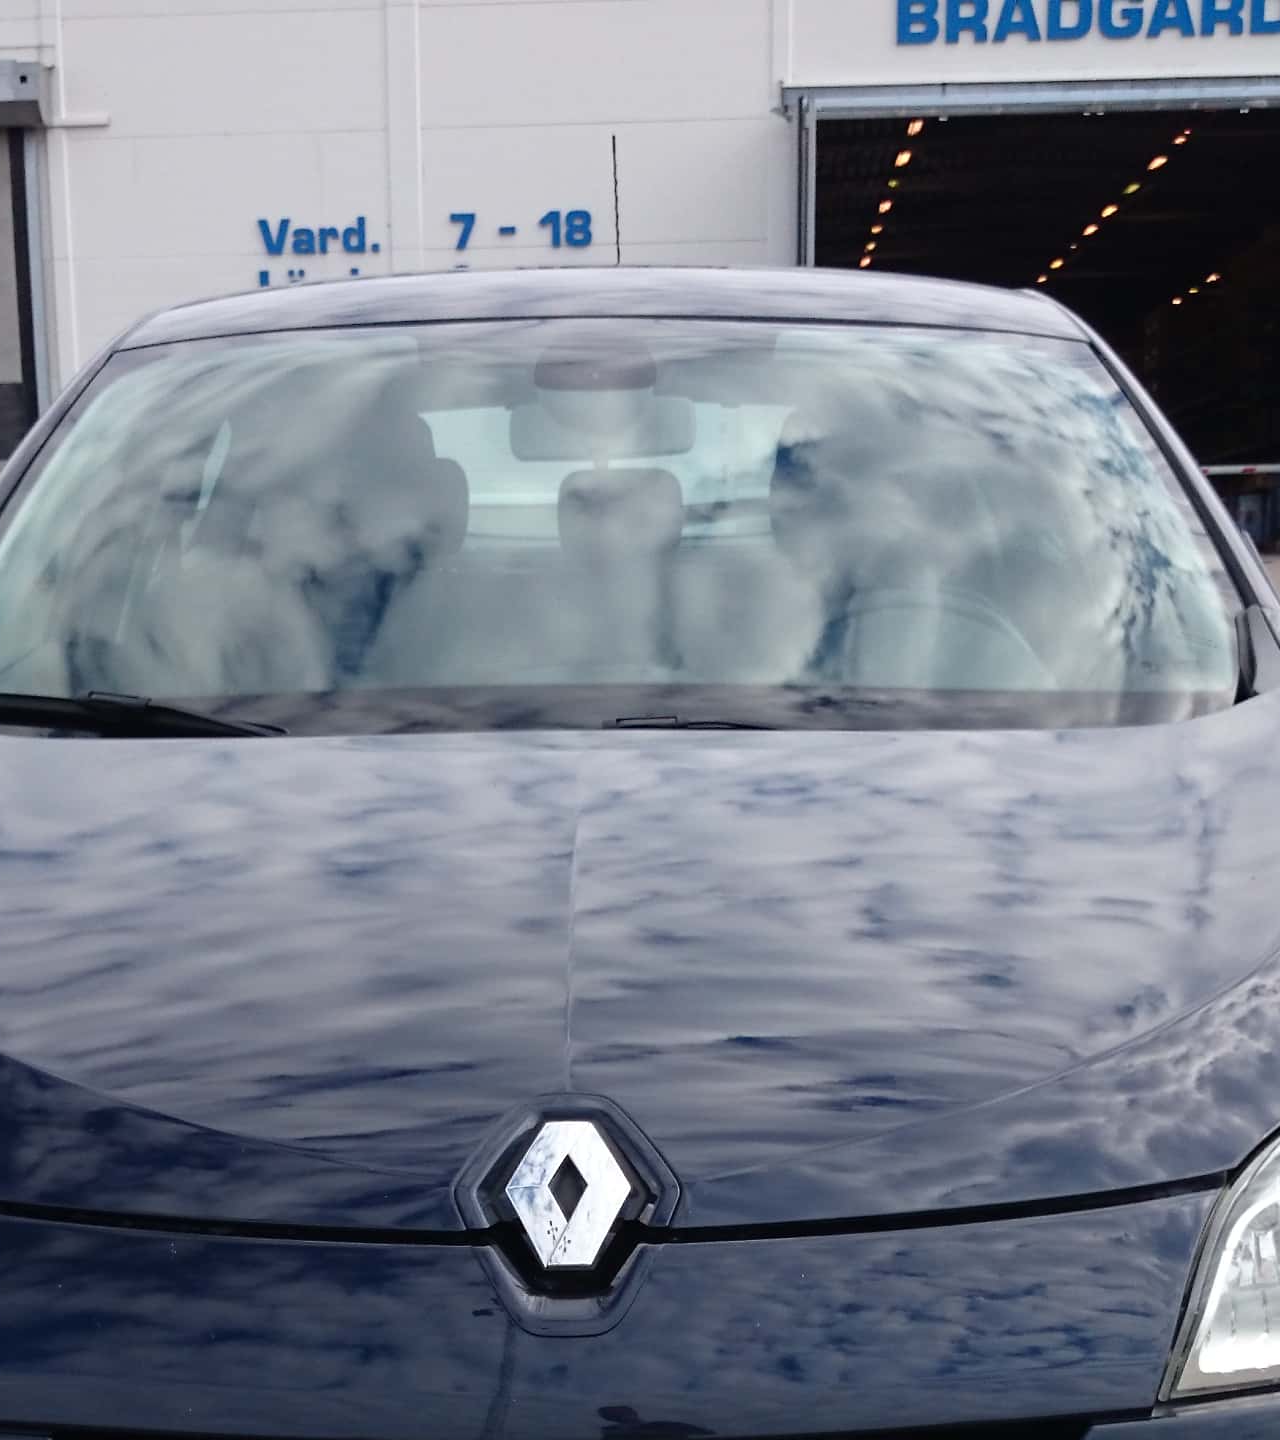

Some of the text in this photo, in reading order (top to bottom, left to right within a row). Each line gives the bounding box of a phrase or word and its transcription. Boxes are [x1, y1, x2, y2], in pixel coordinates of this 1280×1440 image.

[257, 216, 380, 256] Vard.
[449, 213, 477, 251] 7
[538, 210, 593, 249] 18
